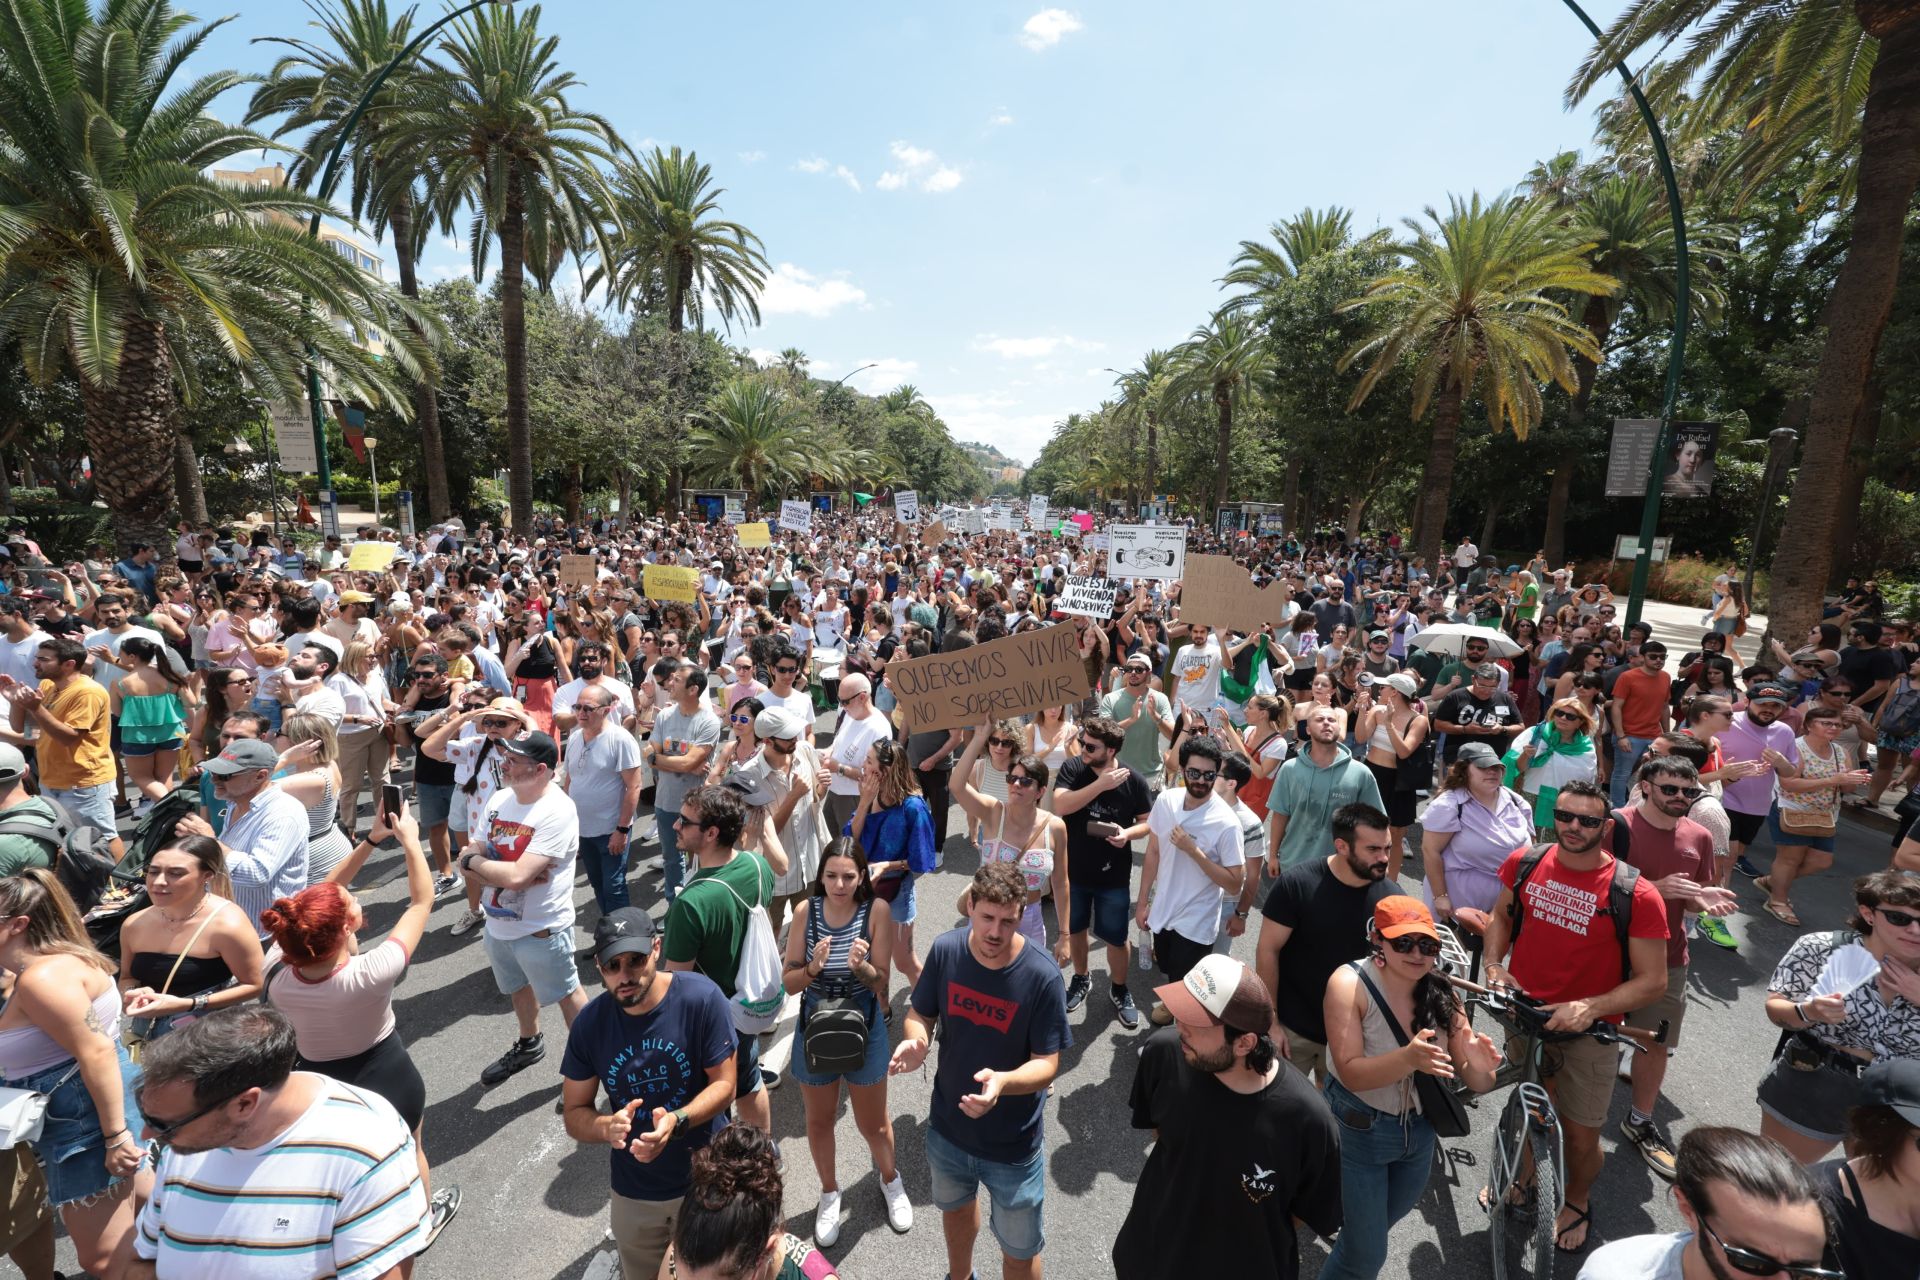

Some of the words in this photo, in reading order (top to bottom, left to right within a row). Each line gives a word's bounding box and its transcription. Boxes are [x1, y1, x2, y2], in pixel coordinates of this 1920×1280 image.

[1676, 433, 1687, 441] De
[1688, 434, 1711, 442] Rafael
[786, 511, 807, 521] VIVIENDA
[1090, 577, 1100, 588] ES
[1069, 599, 1081, 609] NO
[1072, 588, 1114, 602] VIVIENDA
[896, 651, 1007, 696] QUEREMOS
[912, 702, 937, 726] NO
[951, 676, 1079, 716] SOBREVIVIR
[1527, 884, 1539, 895] DE
[1539, 887, 1594, 914] INQUILINAS
[1547, 880, 1597, 903] SINDICATO
[1529, 896, 1536, 905] E
[1535, 898, 1590, 926] INQUILINOS
[1533, 909, 1545, 920] DE
[1546, 913, 1587, 936] MÁLAGA
[953, 993, 1007, 1021] Levi's
[607, 1045, 634, 1092] TOMMY
[642, 1038, 691, 1080] HILFIGER
[1241, 1173, 1276, 1192] VANS
[276, 1217, 290, 1227] Lee
